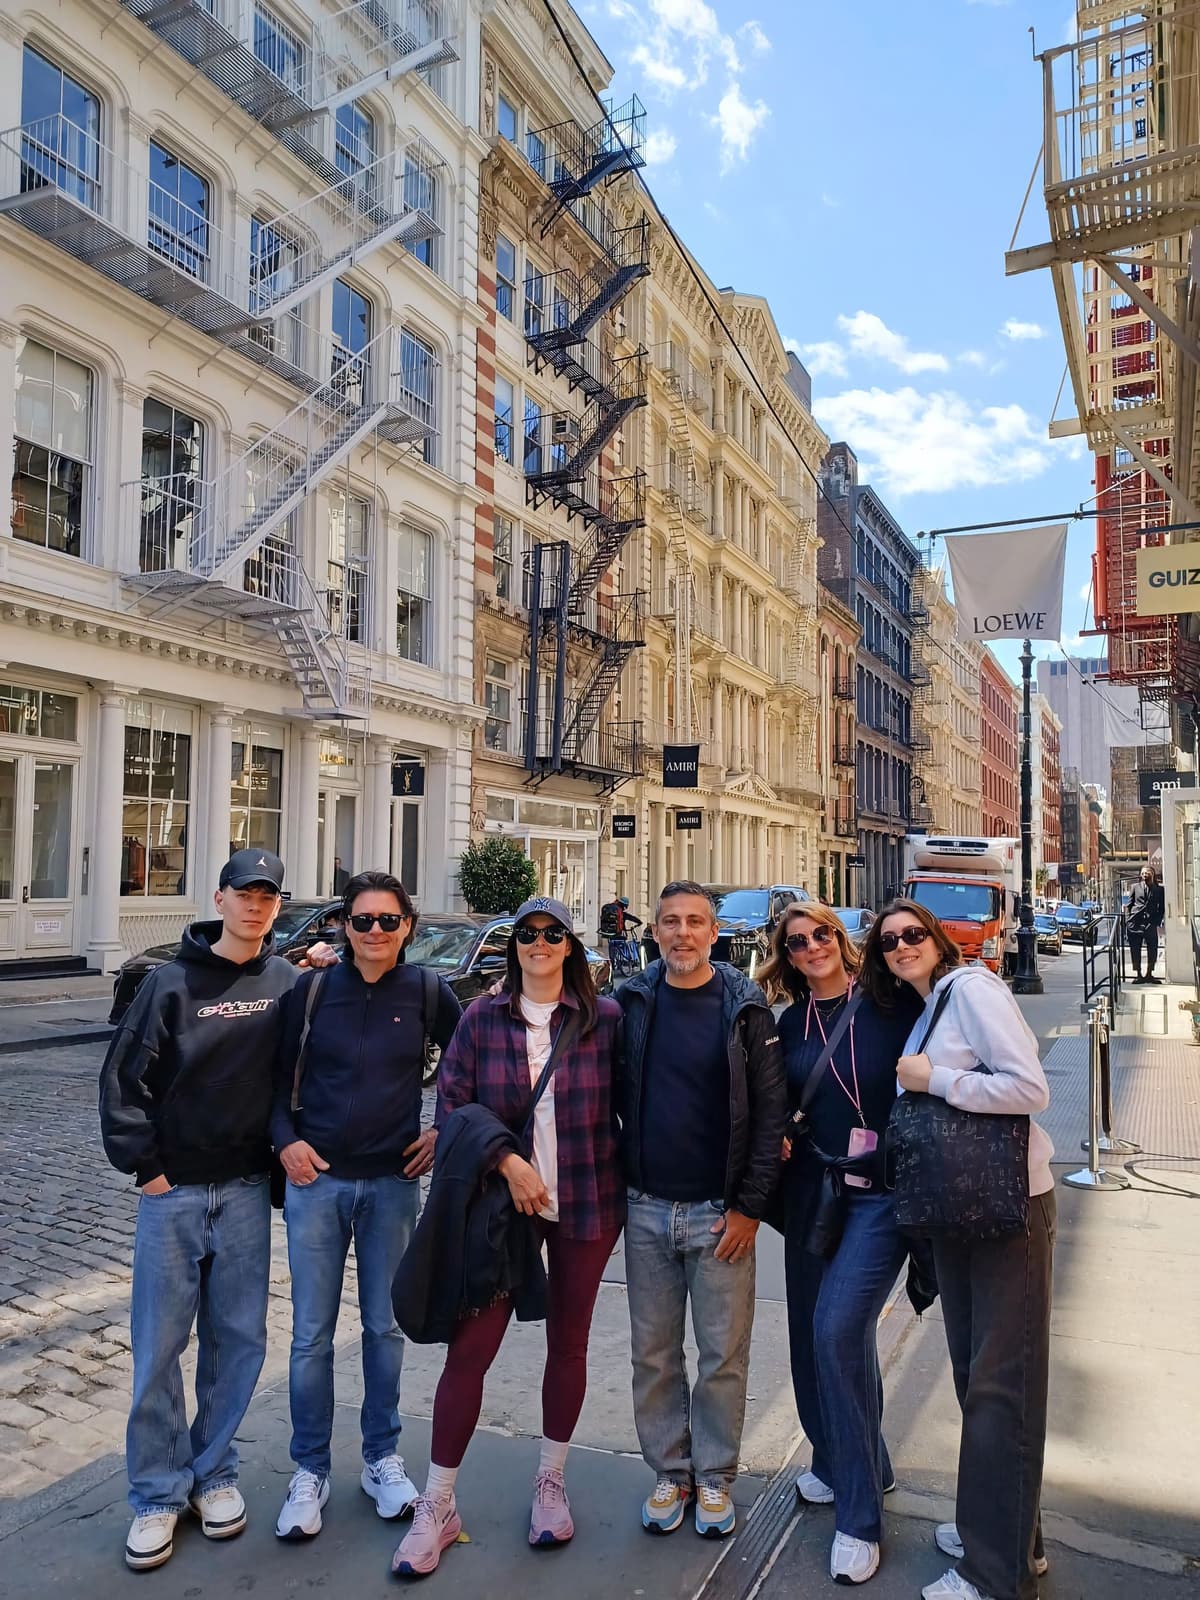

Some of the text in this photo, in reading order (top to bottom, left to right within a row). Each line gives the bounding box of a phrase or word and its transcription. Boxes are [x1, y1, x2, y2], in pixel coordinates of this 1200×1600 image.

[1149, 568, 1200, 588] GUIZ
[973, 612, 1048, 634] LOEWE
[24, 705, 37, 721] 82
[665, 761, 696, 772] AMIRI
[1152, 777, 1181, 791] ami
[678, 816, 699, 824] AMIRI
